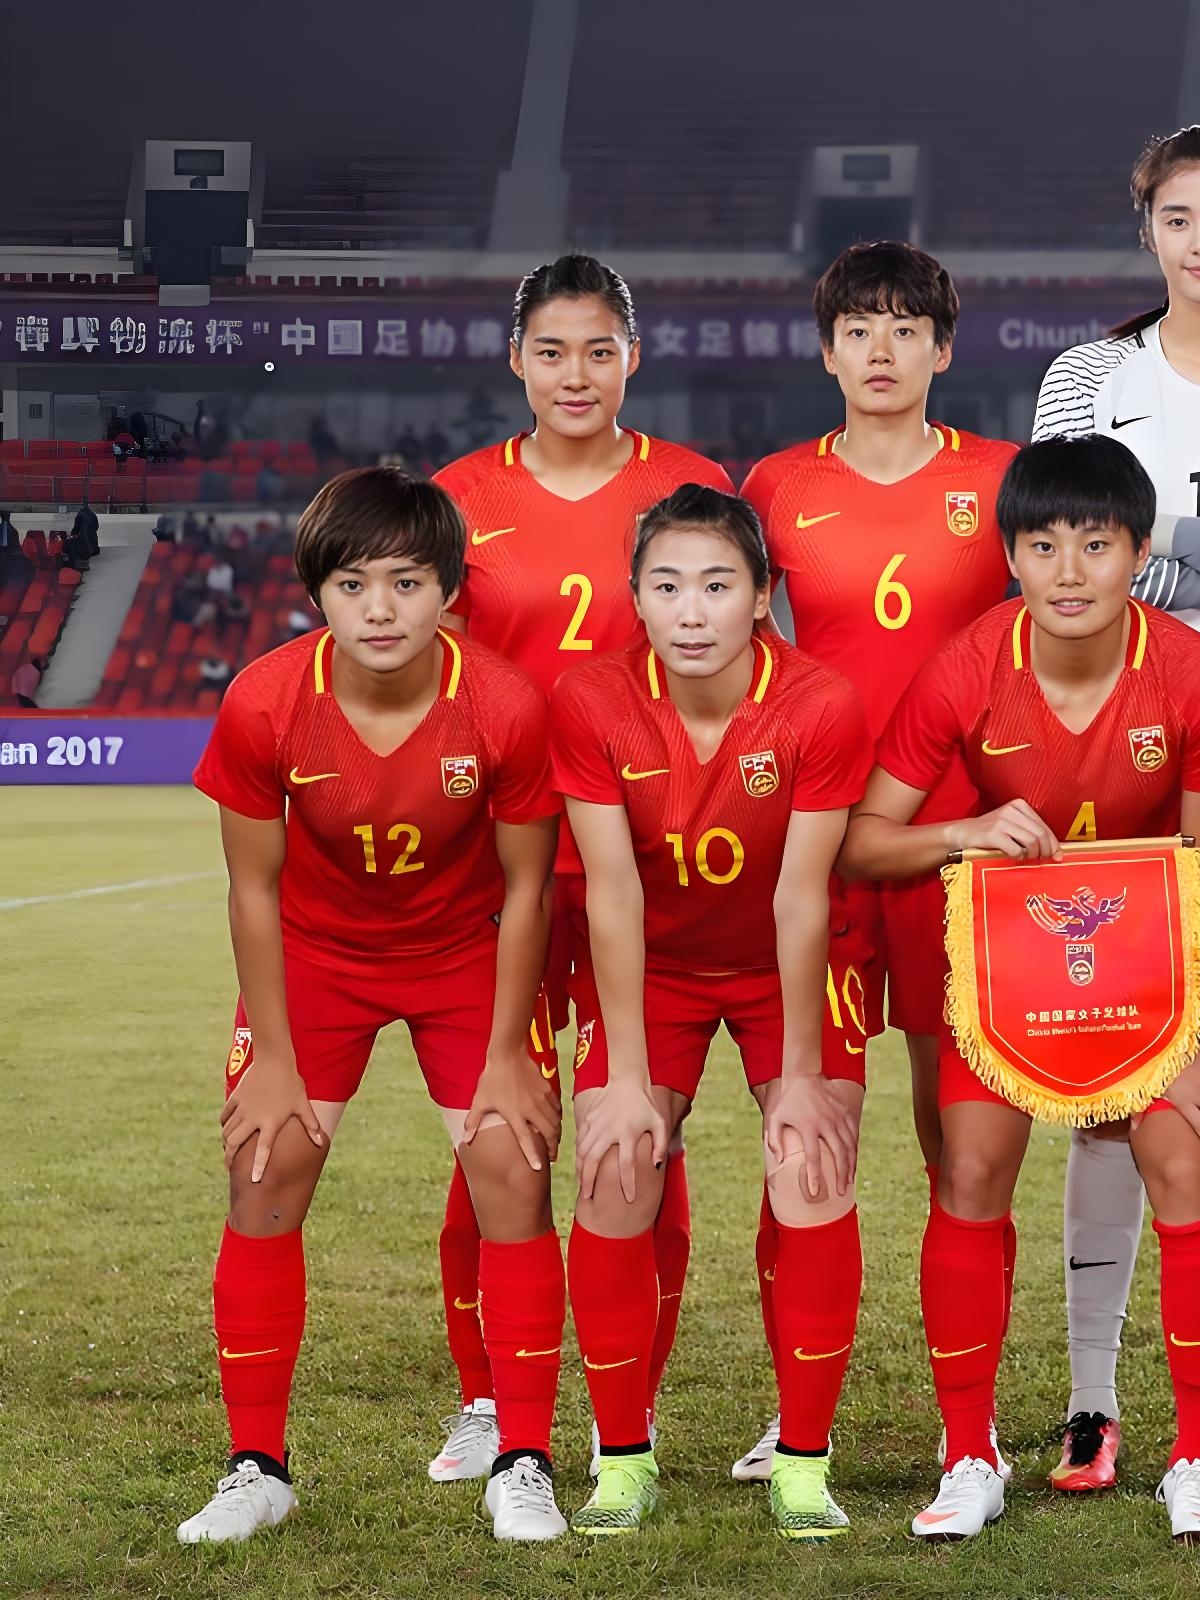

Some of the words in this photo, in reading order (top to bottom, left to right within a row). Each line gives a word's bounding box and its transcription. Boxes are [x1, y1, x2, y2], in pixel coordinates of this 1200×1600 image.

[559, 573, 593, 650] 2
[874, 553, 912, 630] 6
[47, 736, 124, 766] 2017
[1065, 801, 1097, 840] 4
[353, 823, 425, 875] 12
[665, 827, 745, 887] 10
